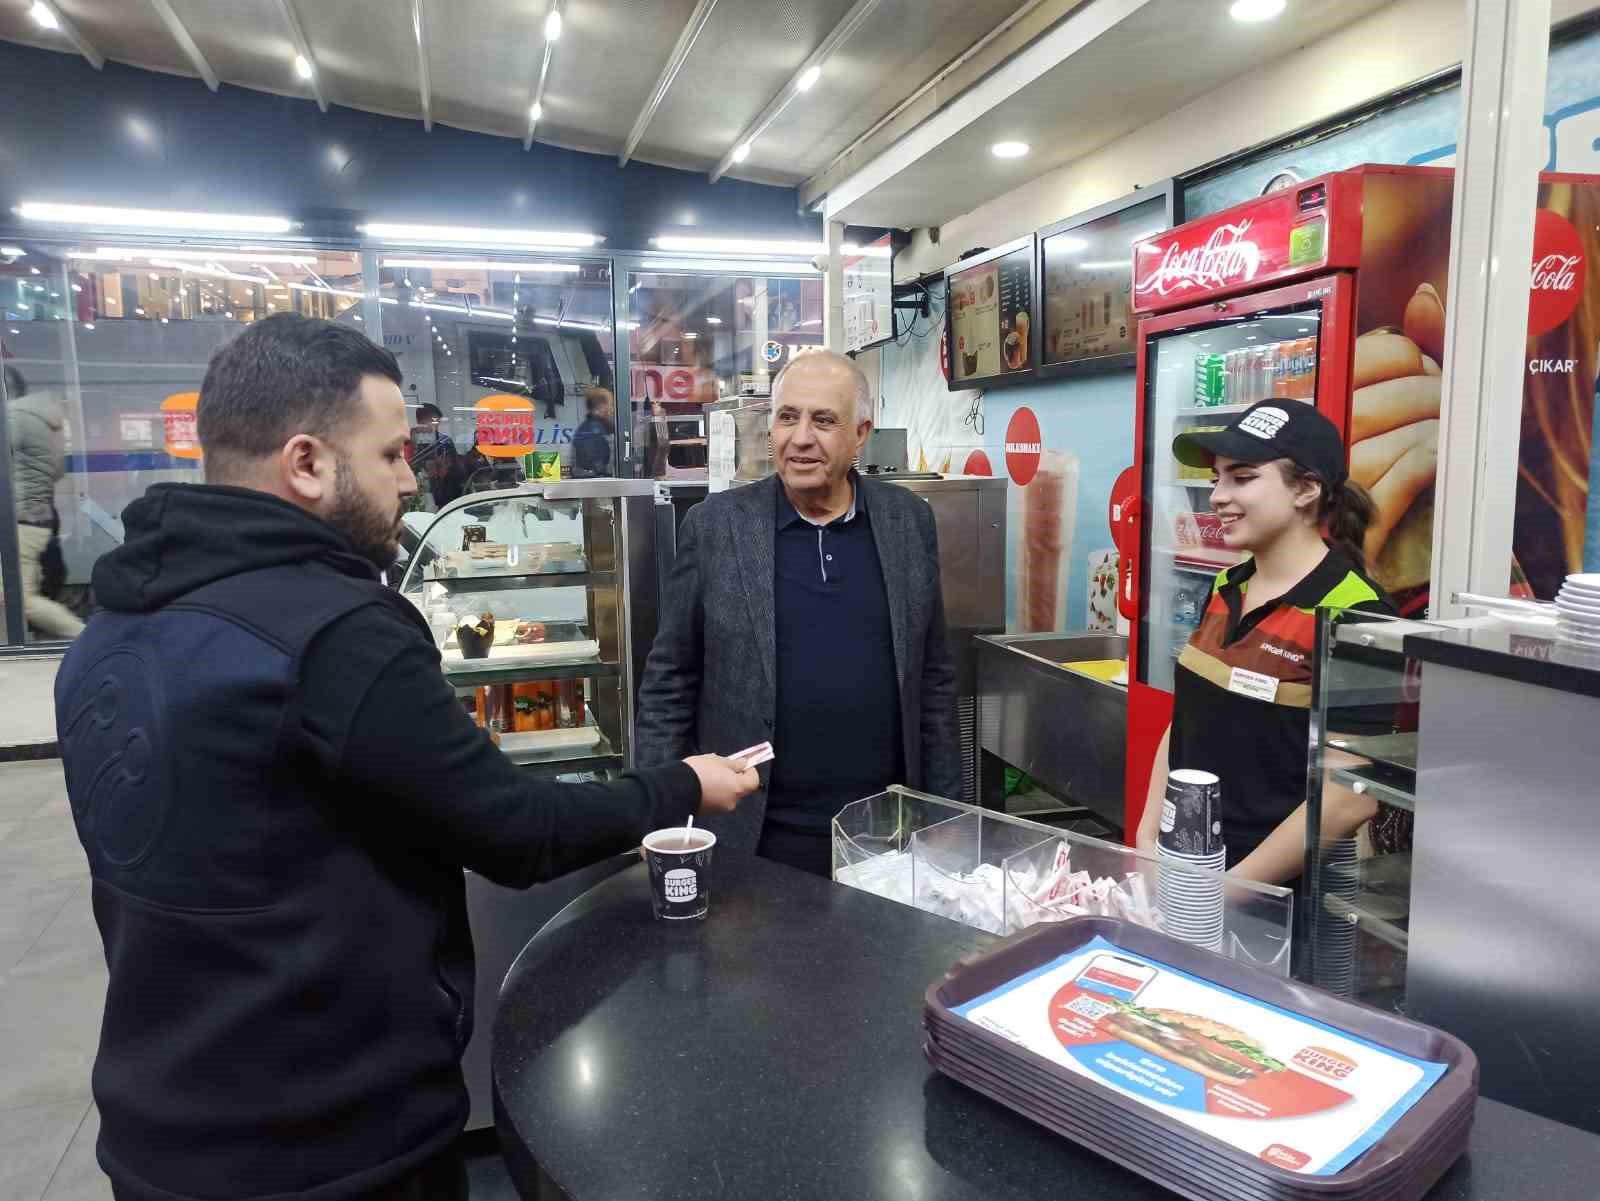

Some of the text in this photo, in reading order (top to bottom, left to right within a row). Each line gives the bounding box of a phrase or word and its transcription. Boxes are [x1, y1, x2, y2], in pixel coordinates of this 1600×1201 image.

[664, 877, 697, 886] BURGER
[665, 885, 697, 896] KING
[1293, 1053, 1348, 1078] KING
